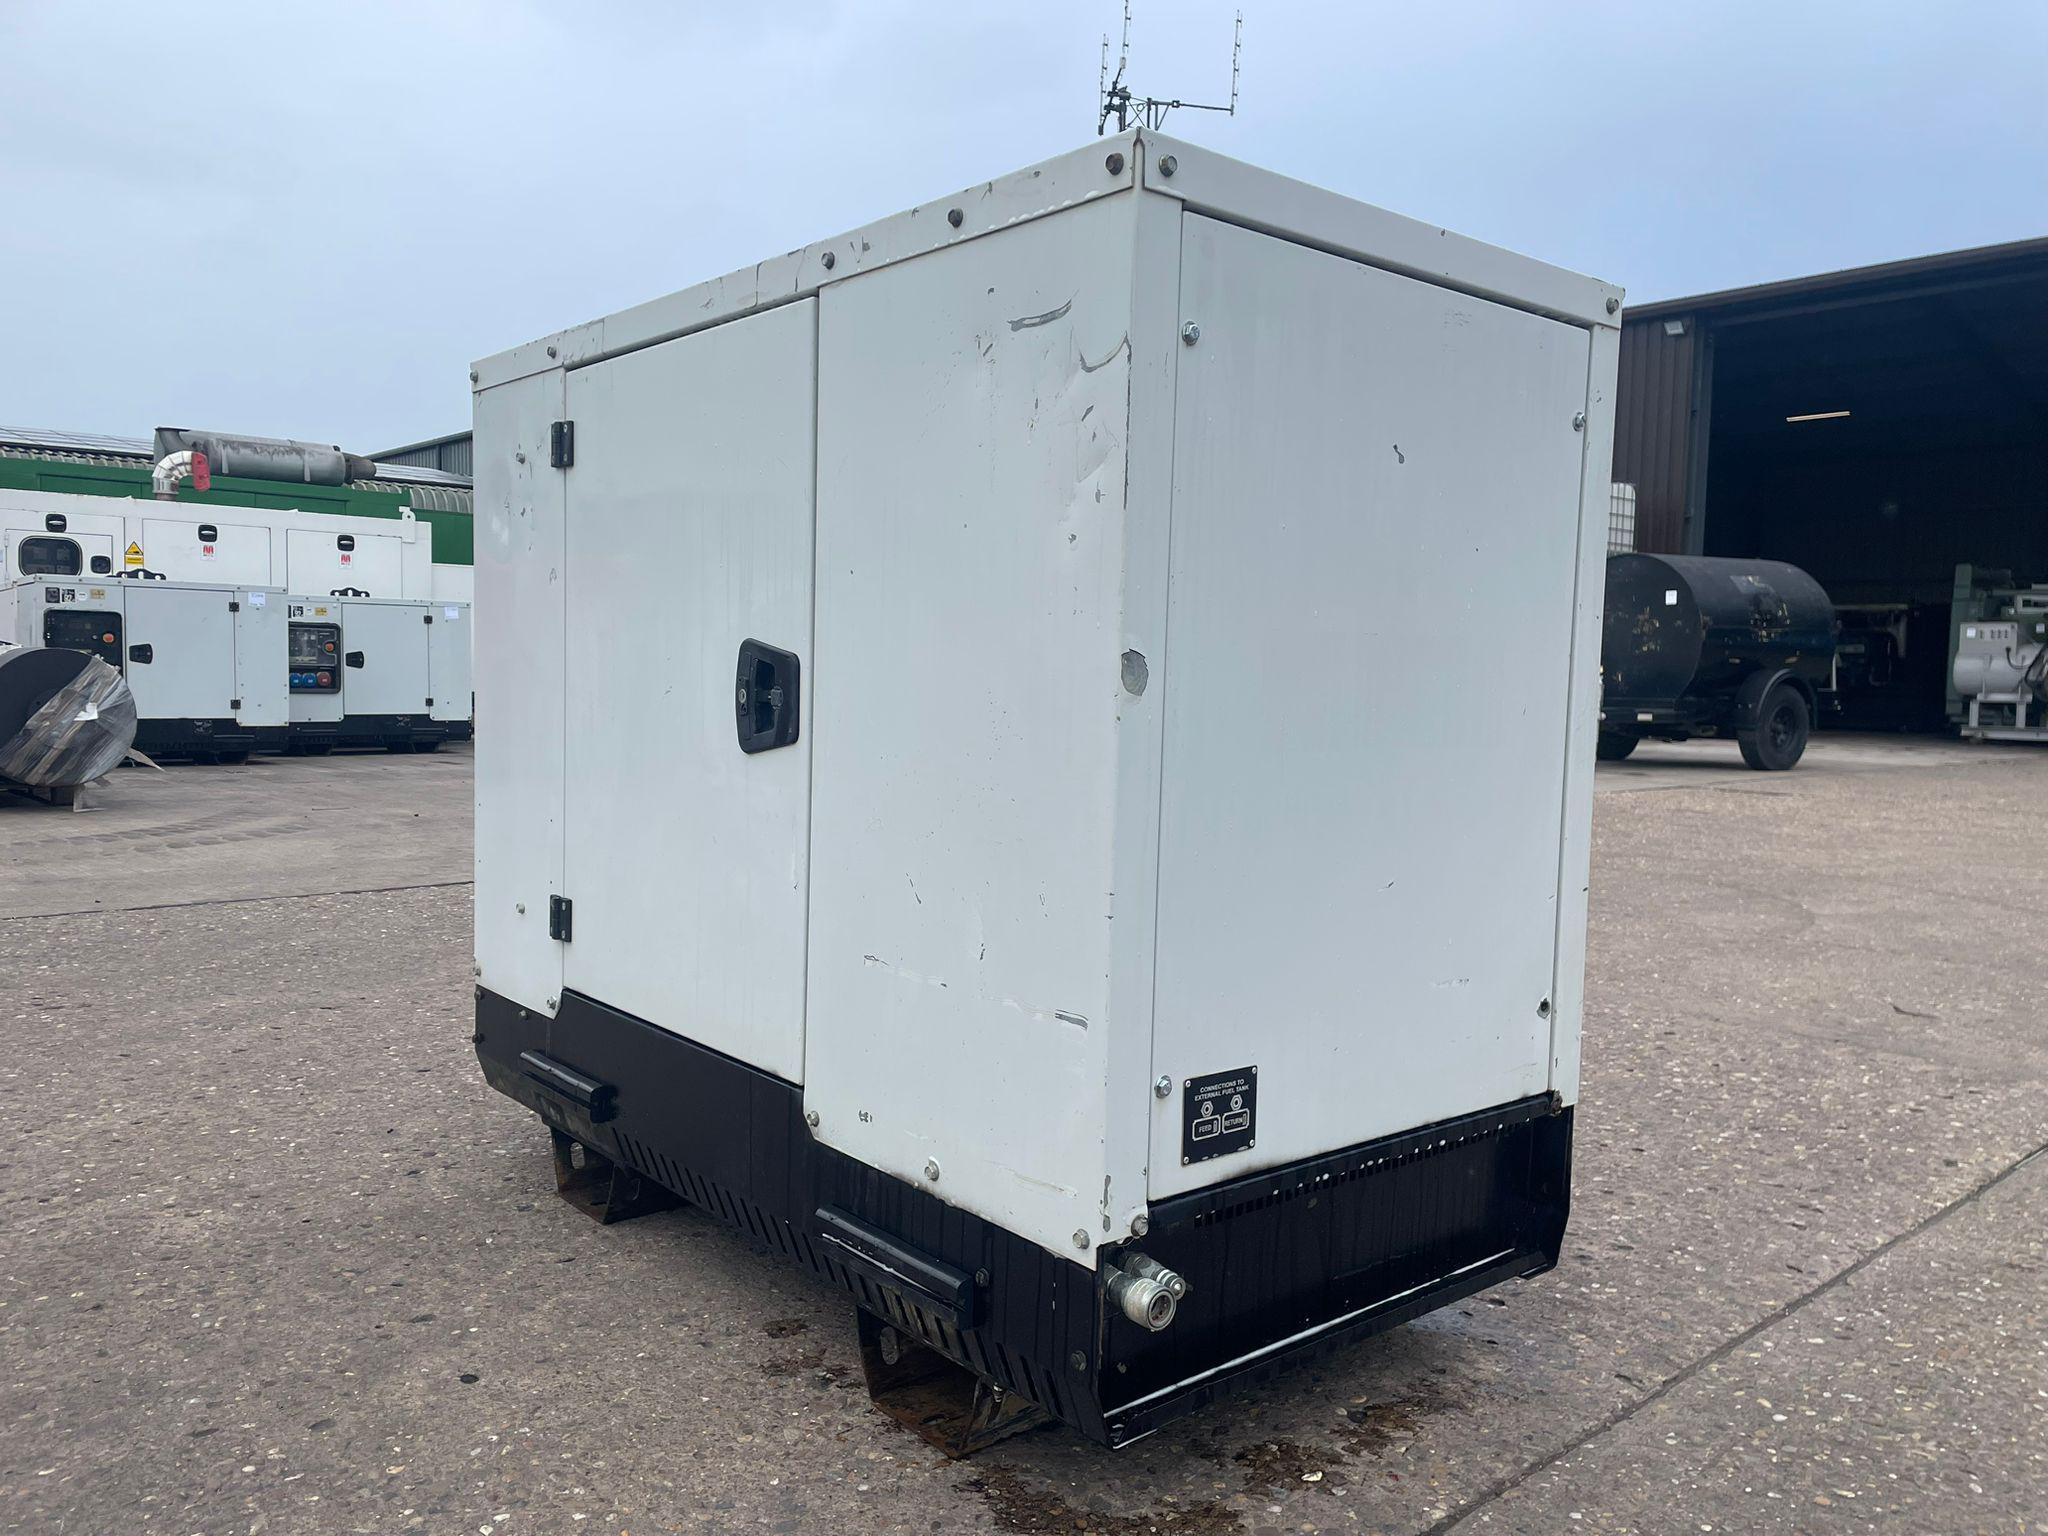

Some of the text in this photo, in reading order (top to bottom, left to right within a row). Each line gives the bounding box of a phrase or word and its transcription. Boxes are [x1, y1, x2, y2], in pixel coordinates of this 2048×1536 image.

[1200, 1081, 1236, 1093] CONNECTIONS
[1194, 1084, 1249, 1101] EXTERNAL FUEL TANK
[1224, 1117, 1243, 1126] RETURN
[1198, 1124, 1212, 1133] FEED
